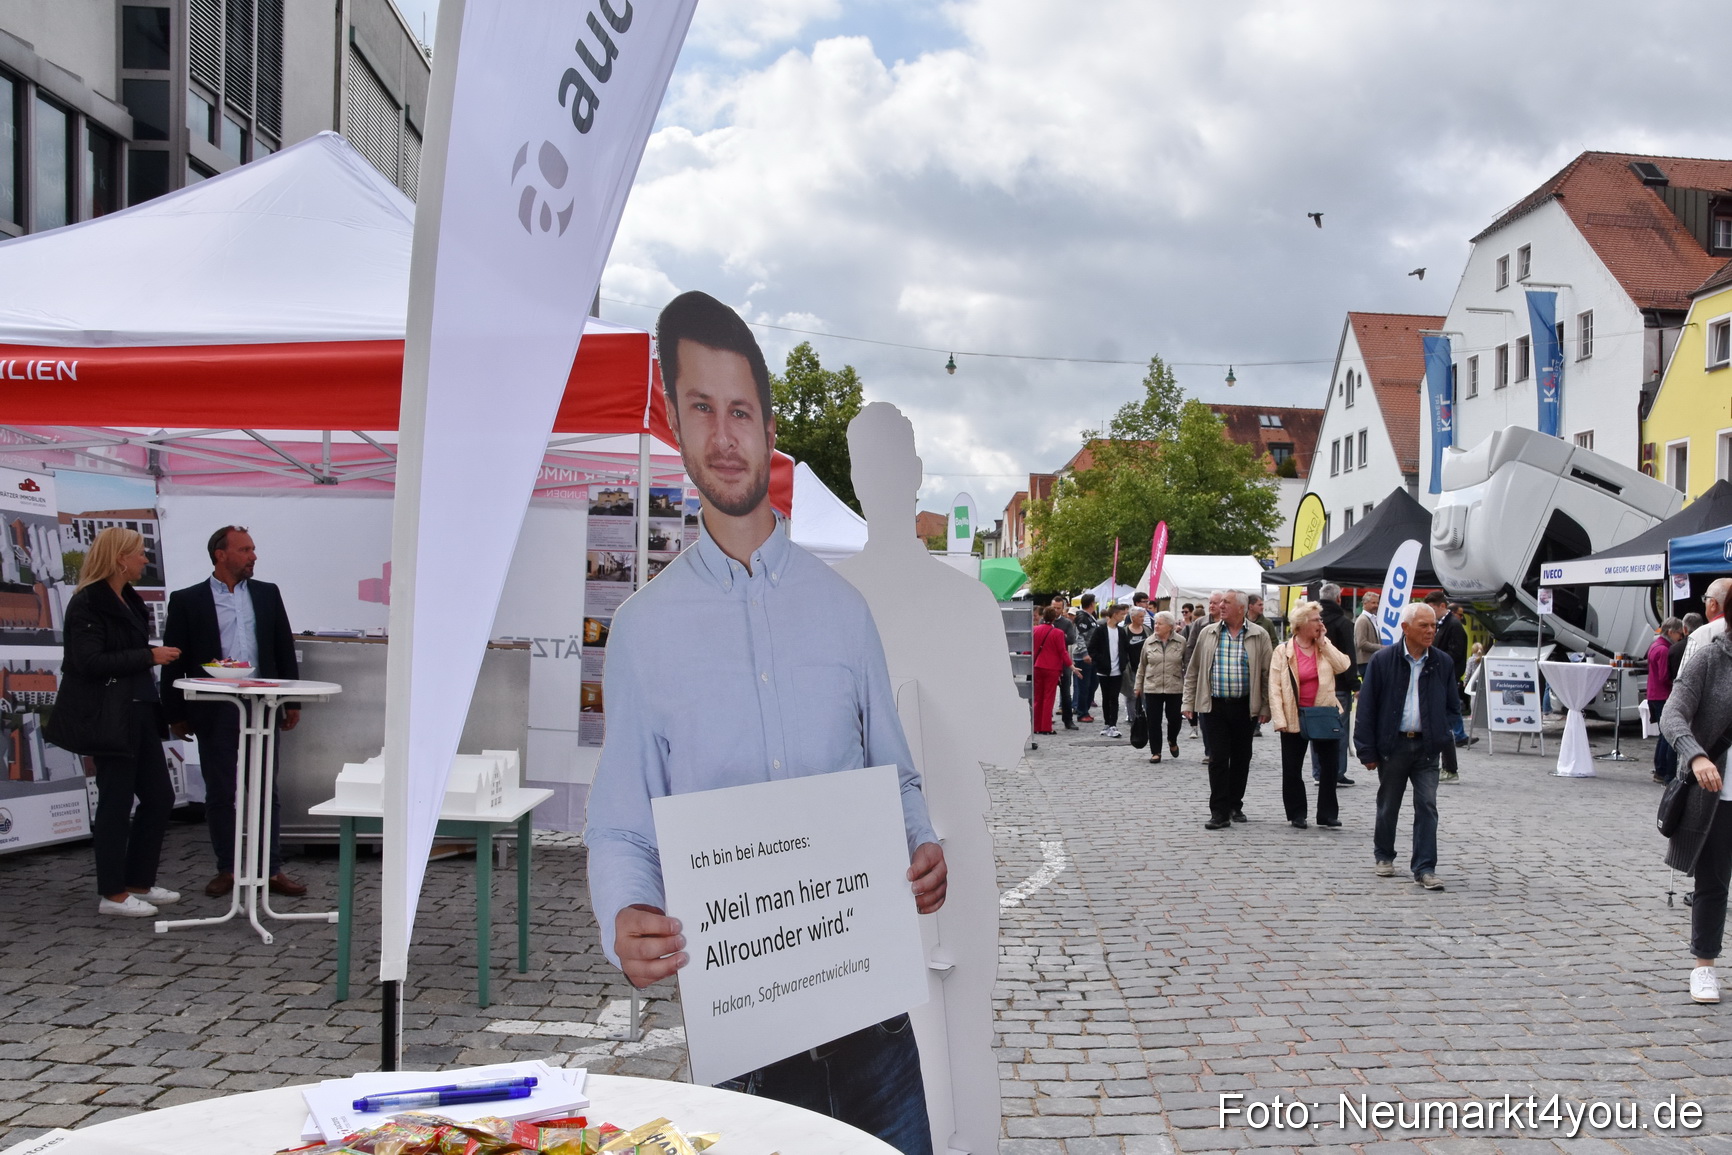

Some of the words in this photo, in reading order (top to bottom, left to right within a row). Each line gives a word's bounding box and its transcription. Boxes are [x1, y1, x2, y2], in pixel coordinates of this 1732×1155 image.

[1543, 569, 1562, 579] IVECO
[1613, 565, 1629, 574] GEORG
[1630, 564, 1646, 573] MEIER
[1380, 566, 1408, 645] VECO
[690, 851, 710, 870] Ich
[713, 848, 733, 865] bin
[736, 843, 755, 861] bei
[757, 836, 811, 857] Auctores:
[755, 888, 795, 914] man
[799, 877, 831, 904] hier
[836, 872, 869, 894] zum
[705, 925, 802, 970] Allrounder
[712, 993, 755, 1017] Hakan,
[758, 957, 870, 1003] Softwareentwicklung
